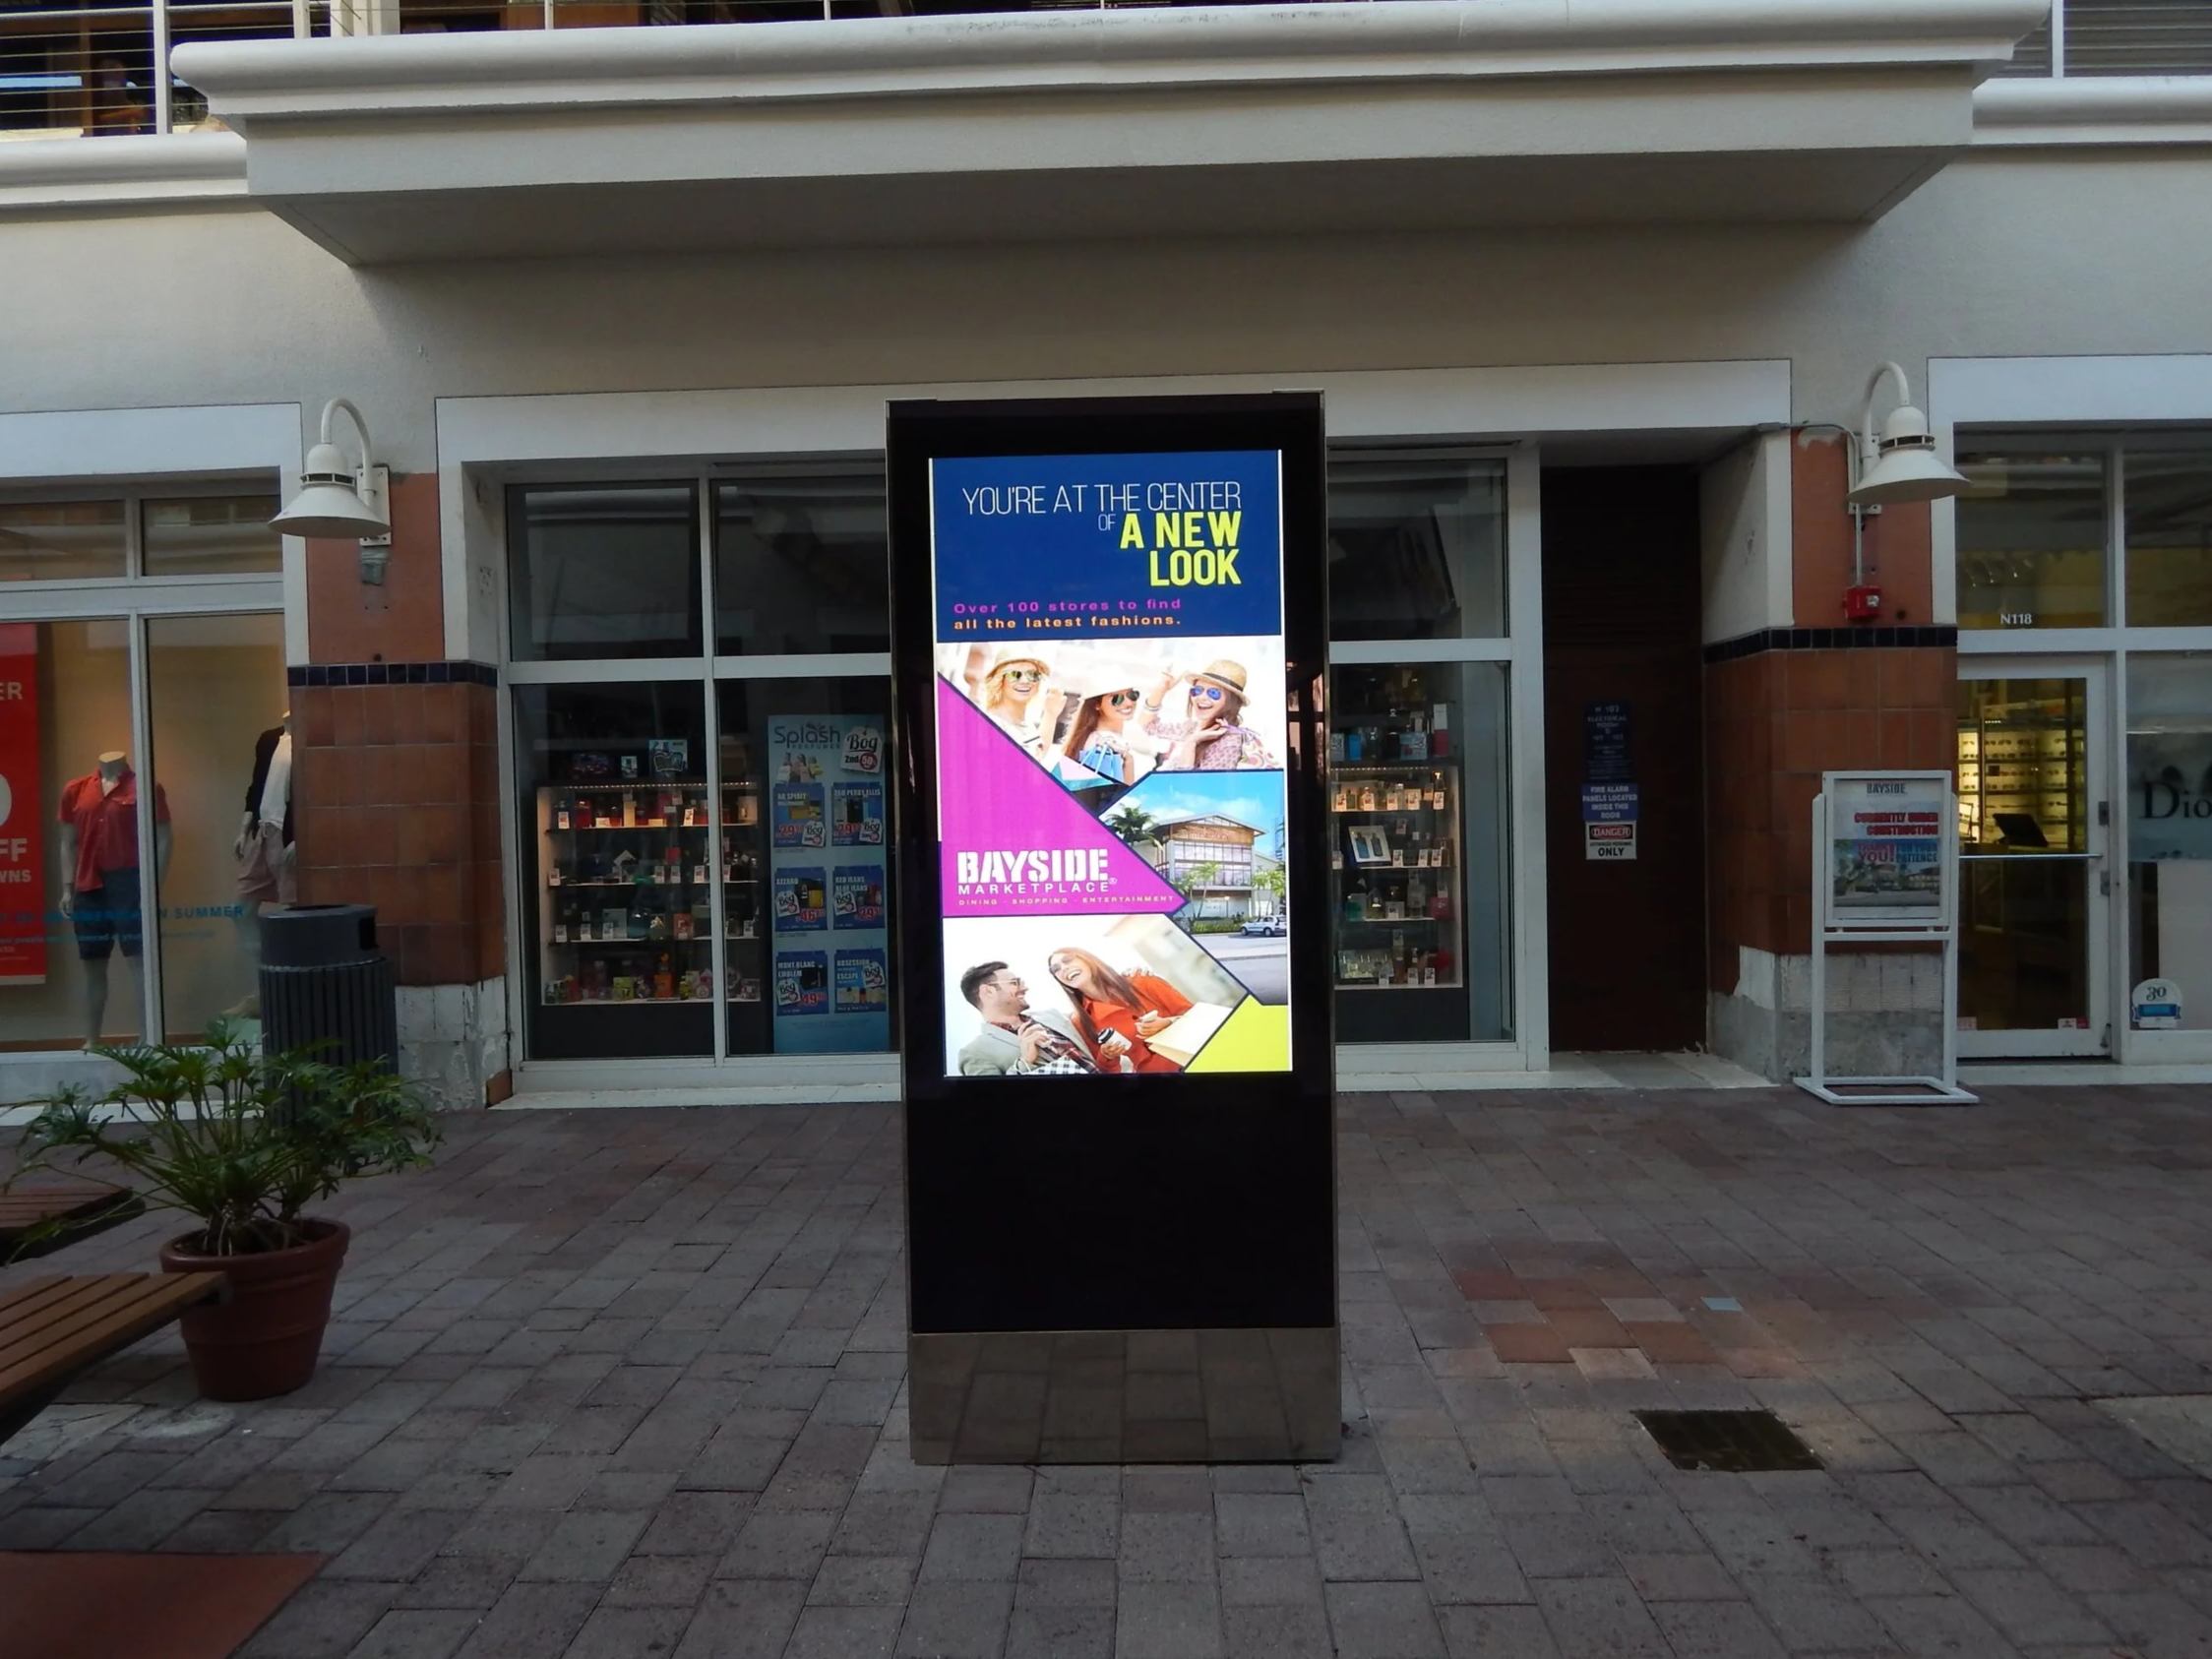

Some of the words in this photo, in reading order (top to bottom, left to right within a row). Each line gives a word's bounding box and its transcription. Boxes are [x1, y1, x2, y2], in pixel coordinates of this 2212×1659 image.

[962, 485, 1046, 515] YOU'RE
[1053, 484, 1087, 513] AT
[1094, 483, 1140, 512] THE
[1146, 481, 1242, 511] CENTER
[1098, 514, 1116, 531] OF
[1120, 513, 1145, 549] A
[1155, 511, 1242, 548] NEW
[1149, 548, 1242, 587] LOOK
[953, 603, 998, 615] Over
[1008, 601, 1040, 613] 100
[1048, 600, 1109, 612] stores
[1118, 599, 1137, 611] to
[1146, 598, 1182, 610] find
[953, 619, 977, 630] all
[986, 618, 1016, 629] the
[1025, 616, 1081, 628] latest
[1091, 614, 1182, 627] fashions.
[1999, 613, 2032, 625] N118
[774, 724, 840, 749] Splash
[846, 734, 878, 754] Bog
[845, 755, 859, 764] 2nd
[1866, 782, 1907, 794] BAYSIDE
[1608, 793, 1637, 802] LOCATED
[2138, 781, 2212, 820] Dio
[1592, 827, 1628, 836] DANGER
[1598, 847, 1624, 857] ONLY
[956, 849, 1109, 885] BAYSIDE
[957, 882, 1109, 895] MARKETPLACE
[1012, 896, 1069, 905] SHOPPING
[1081, 895, 1175, 904] ENTERTAINMENT
[174, 905, 244, 919] SUMMER
[2146, 987, 2167, 1002] 30
